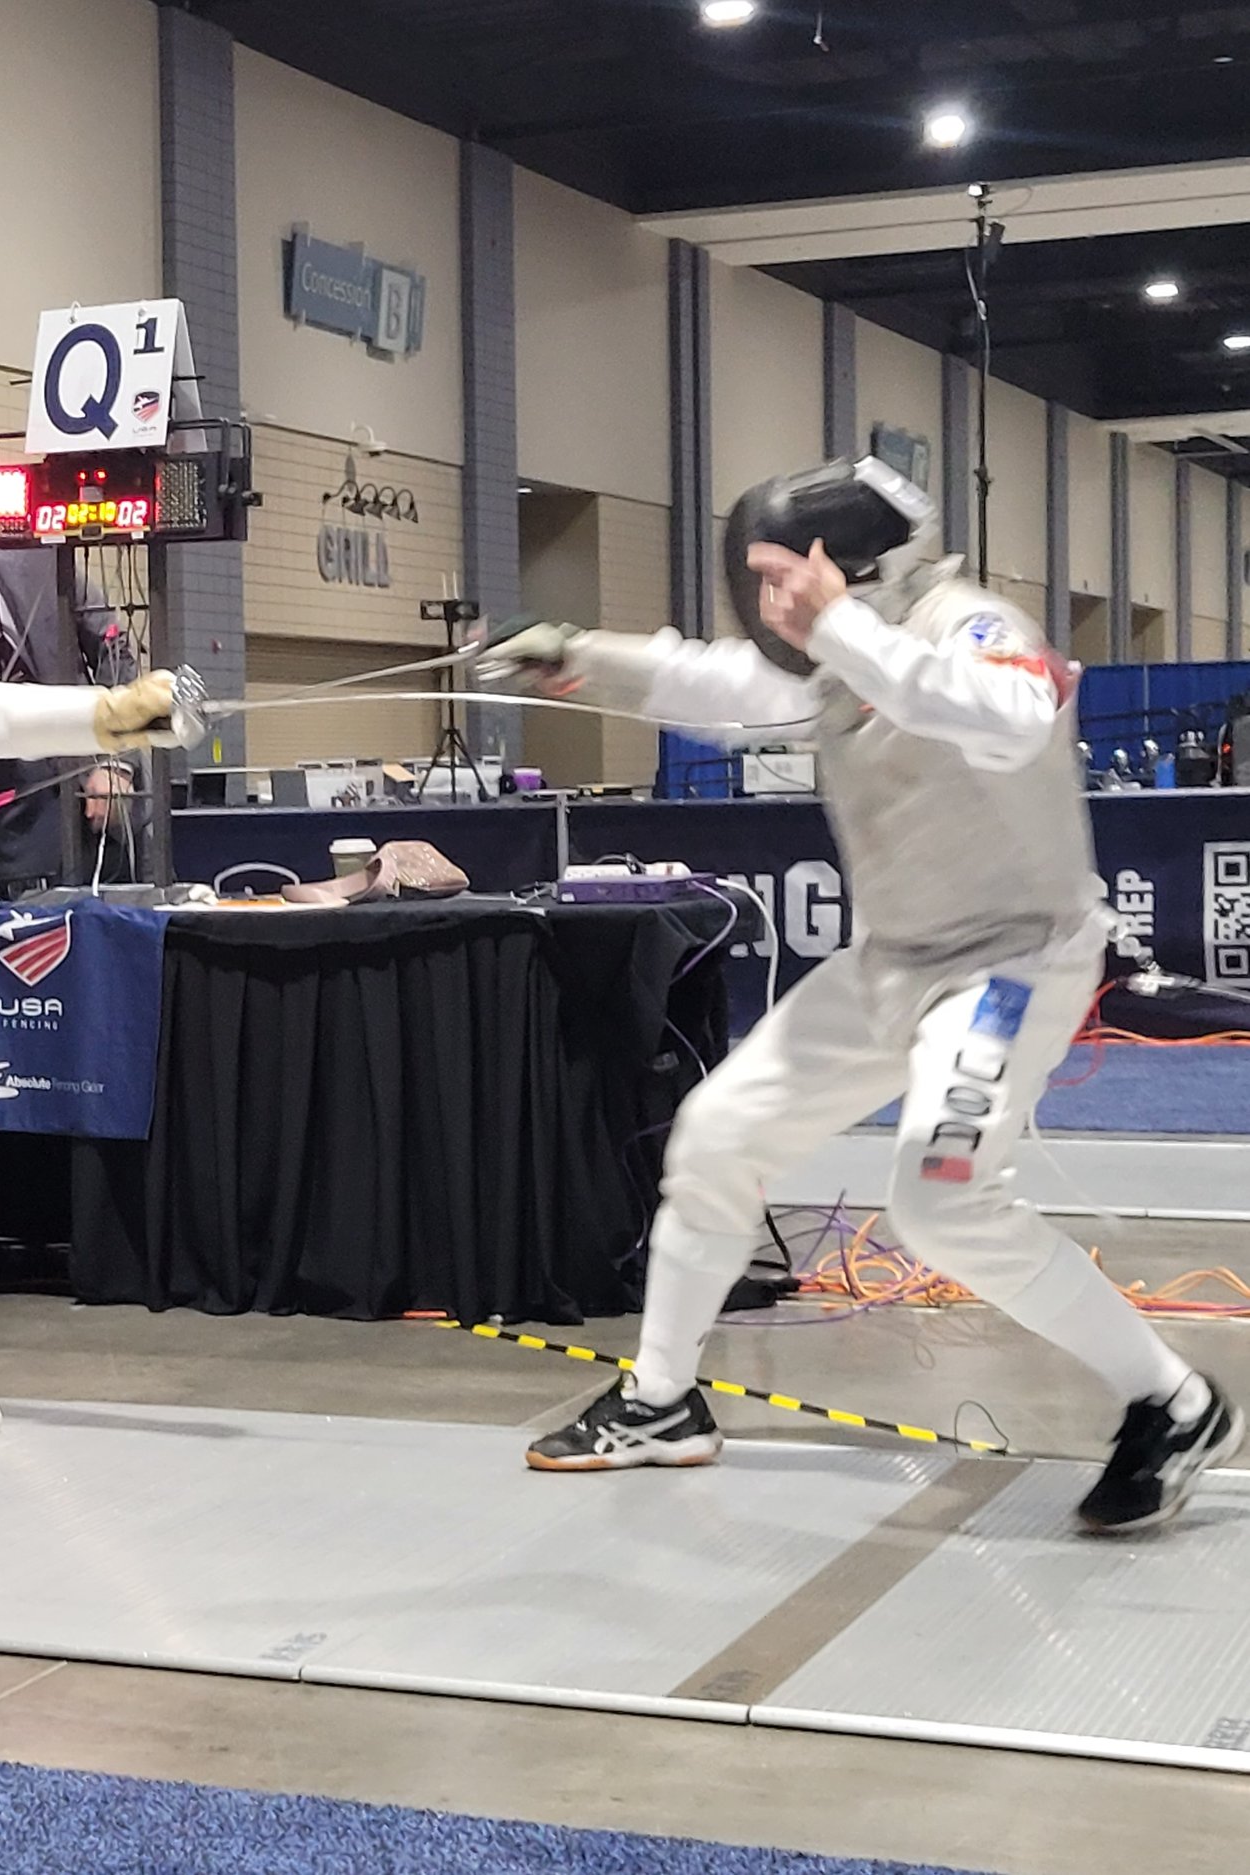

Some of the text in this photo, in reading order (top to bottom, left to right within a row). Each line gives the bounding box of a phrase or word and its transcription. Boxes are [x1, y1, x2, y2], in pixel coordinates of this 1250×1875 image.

[302, 261, 401, 341] Concession B
[44, 316, 164, 441] Q 1
[35, 505, 66, 532] 02
[116, 499, 147, 527] 02
[317, 524, 391, 589] GRILL
[1115, 869, 1155, 959] PREP
[2, 1018, 59, 1031] FENCING
[5, 1074, 52, 1091] Absolute
